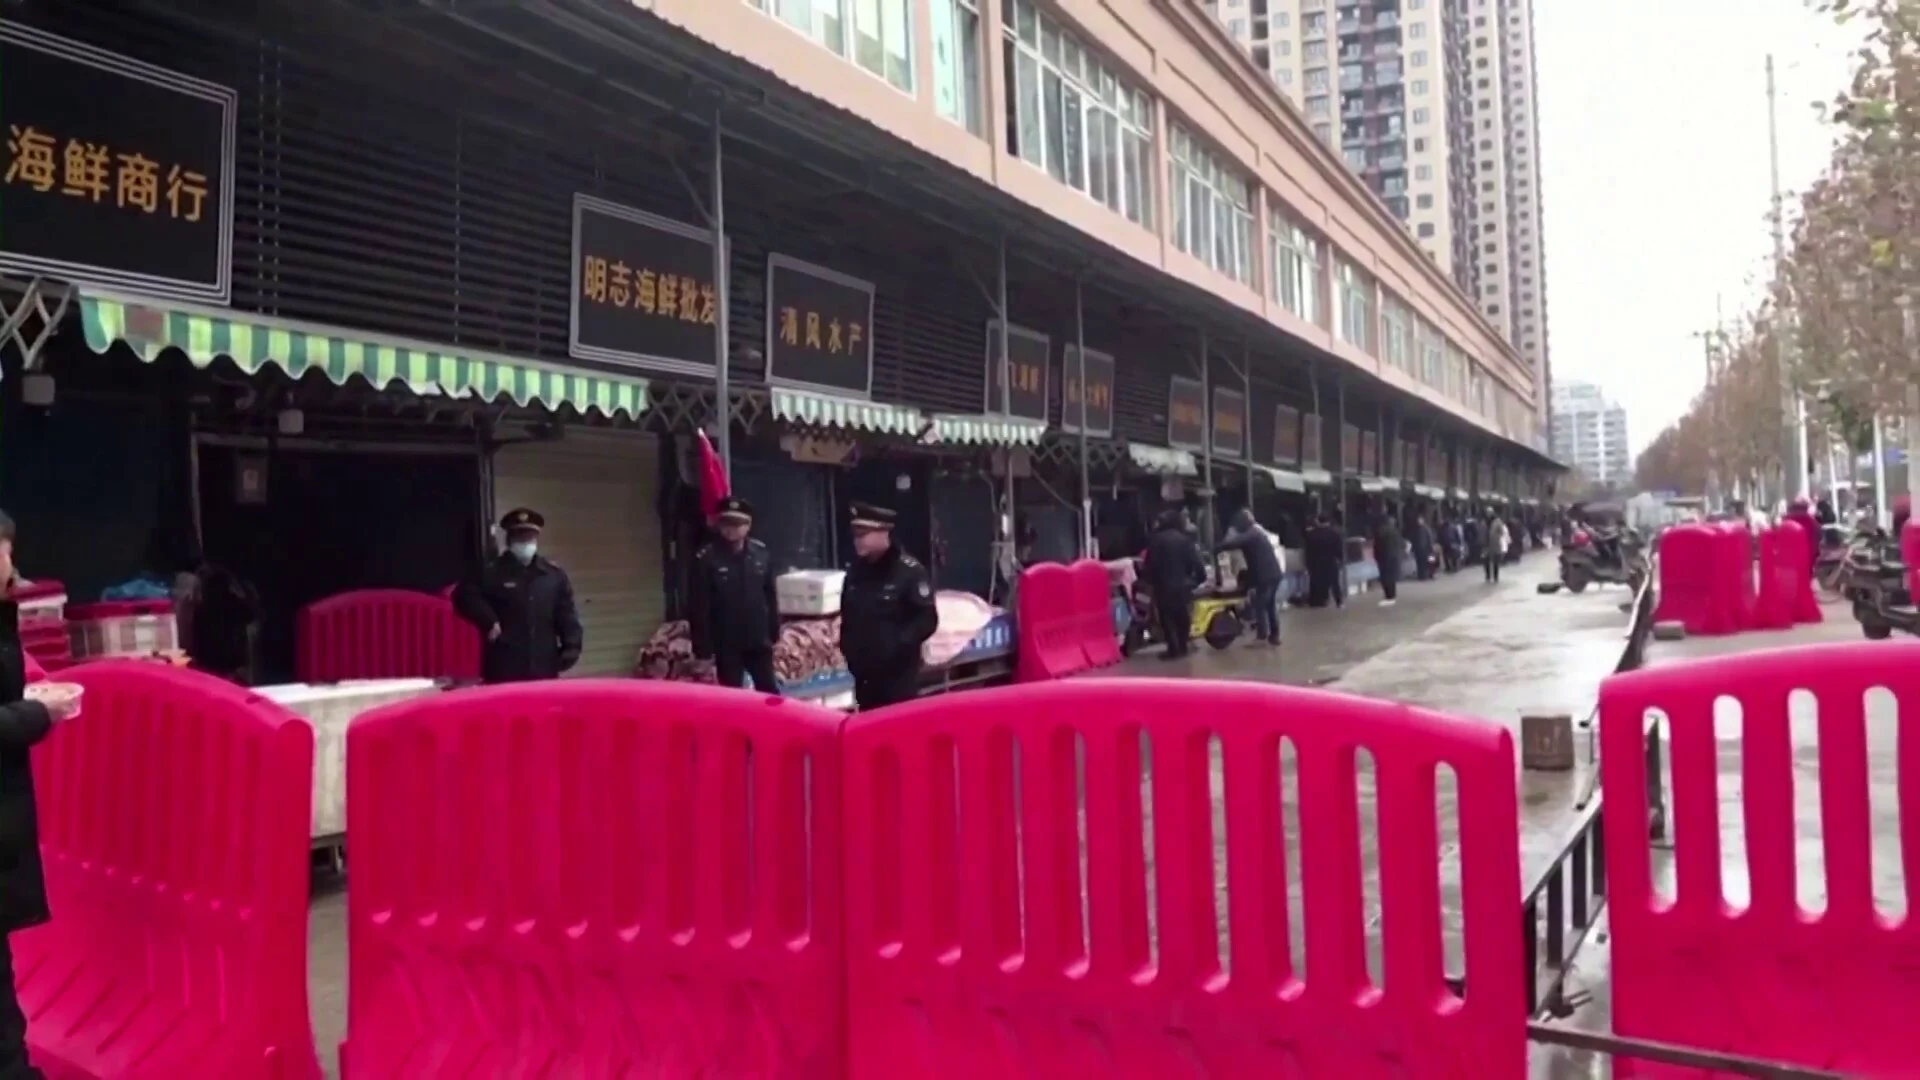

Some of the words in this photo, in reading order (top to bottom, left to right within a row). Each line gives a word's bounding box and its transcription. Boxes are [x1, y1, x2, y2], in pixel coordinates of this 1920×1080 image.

[5, 124, 208, 221] 海鲜商行
[584, 255, 717, 324] 明志海鲜批发
[780, 306, 862, 355] 清风水产
